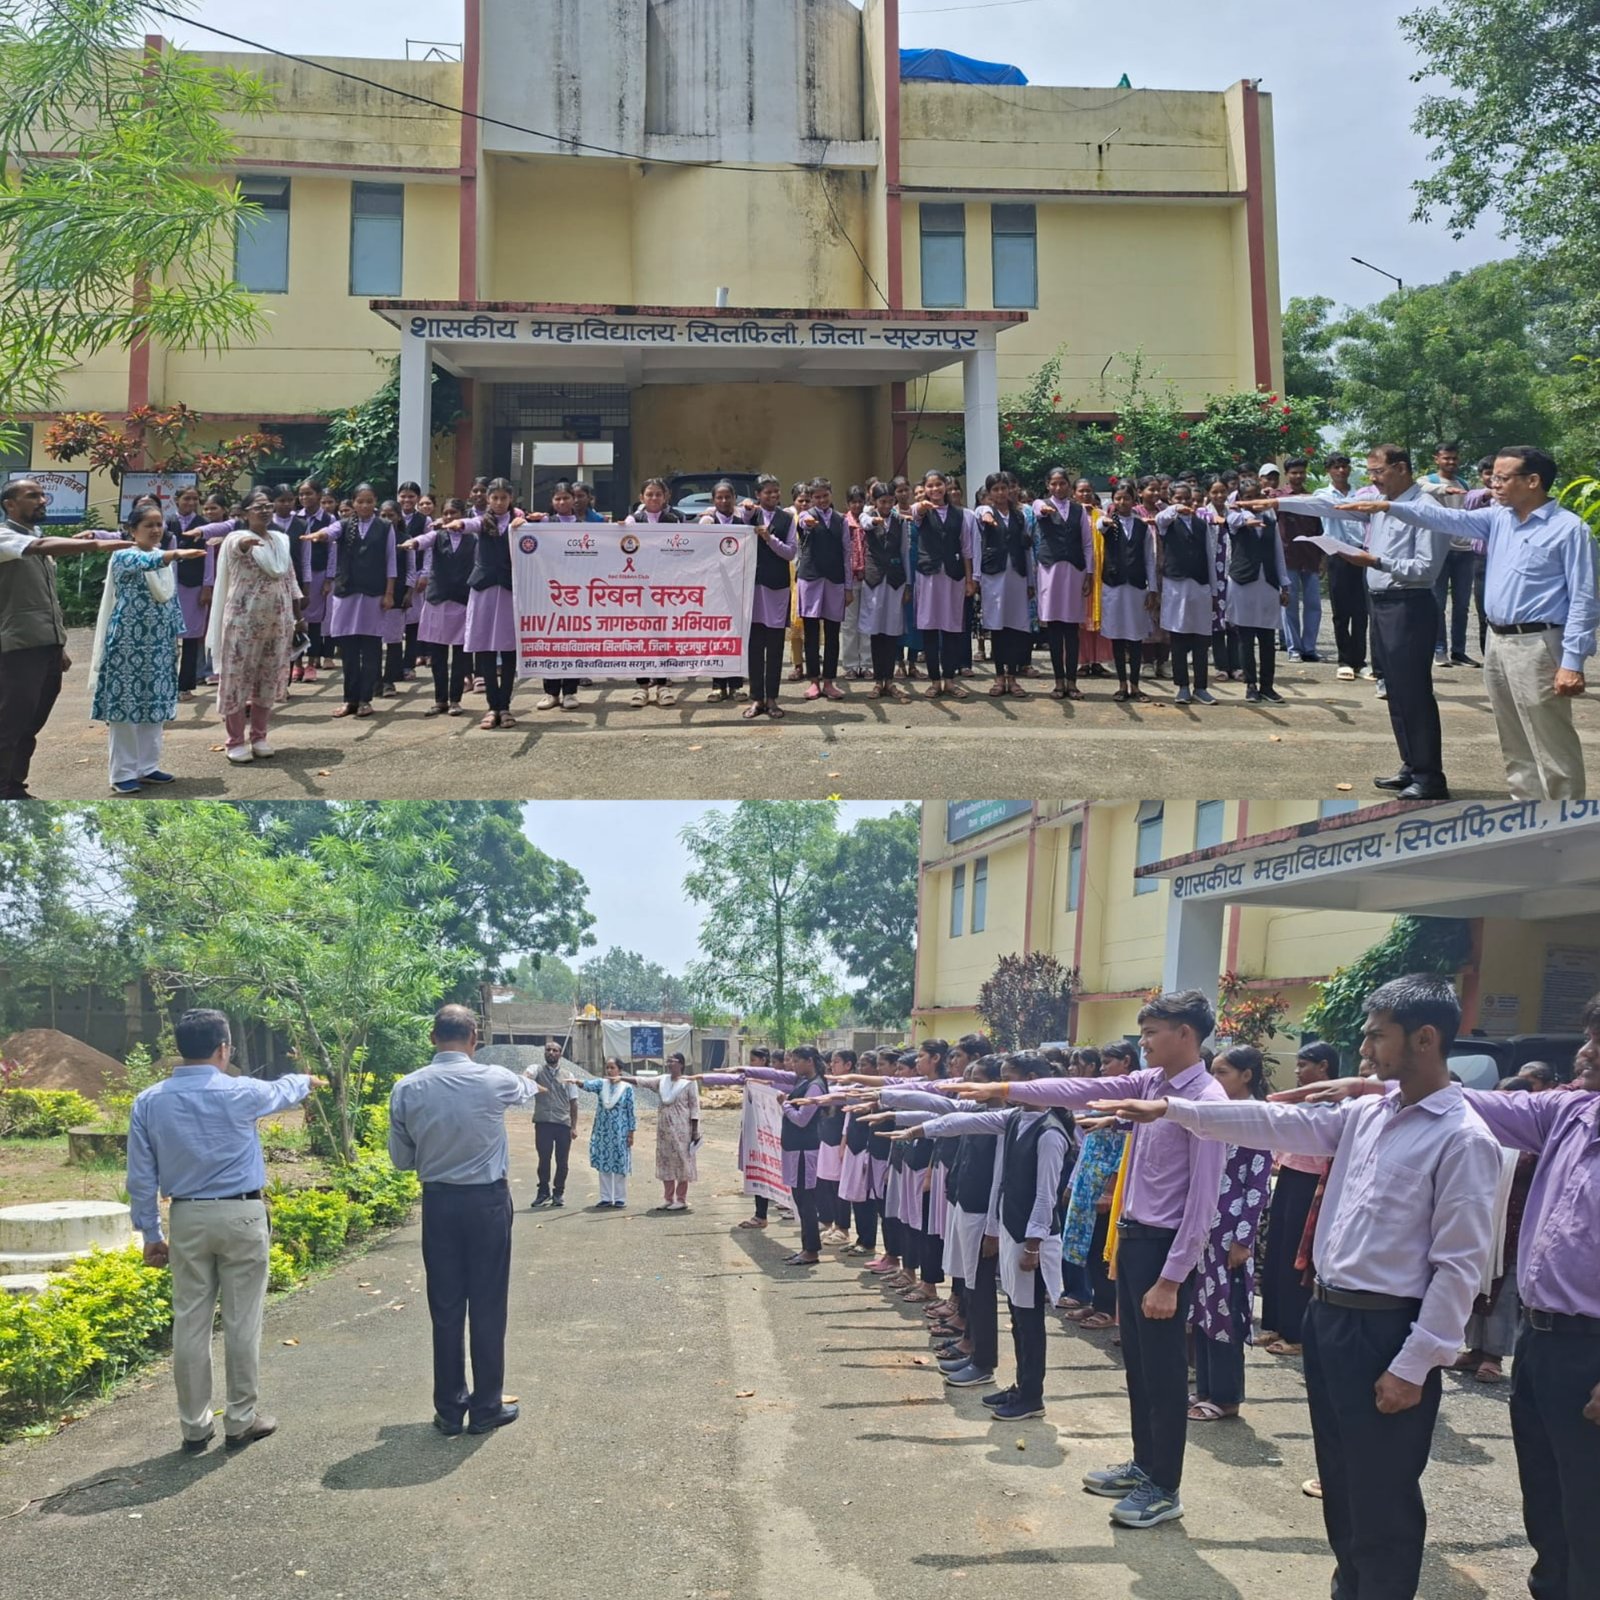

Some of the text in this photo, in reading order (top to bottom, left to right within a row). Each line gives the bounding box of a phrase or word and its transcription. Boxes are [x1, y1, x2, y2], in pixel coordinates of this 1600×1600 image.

[410, 315, 519, 339] शासकीय
[548, 577, 707, 607] रेड रिबन क्लब
[520, 612, 592, 636] HIV/AIDS
[671, 611, 733, 632] अभियान
[1173, 862, 1246, 898] शासकीय
